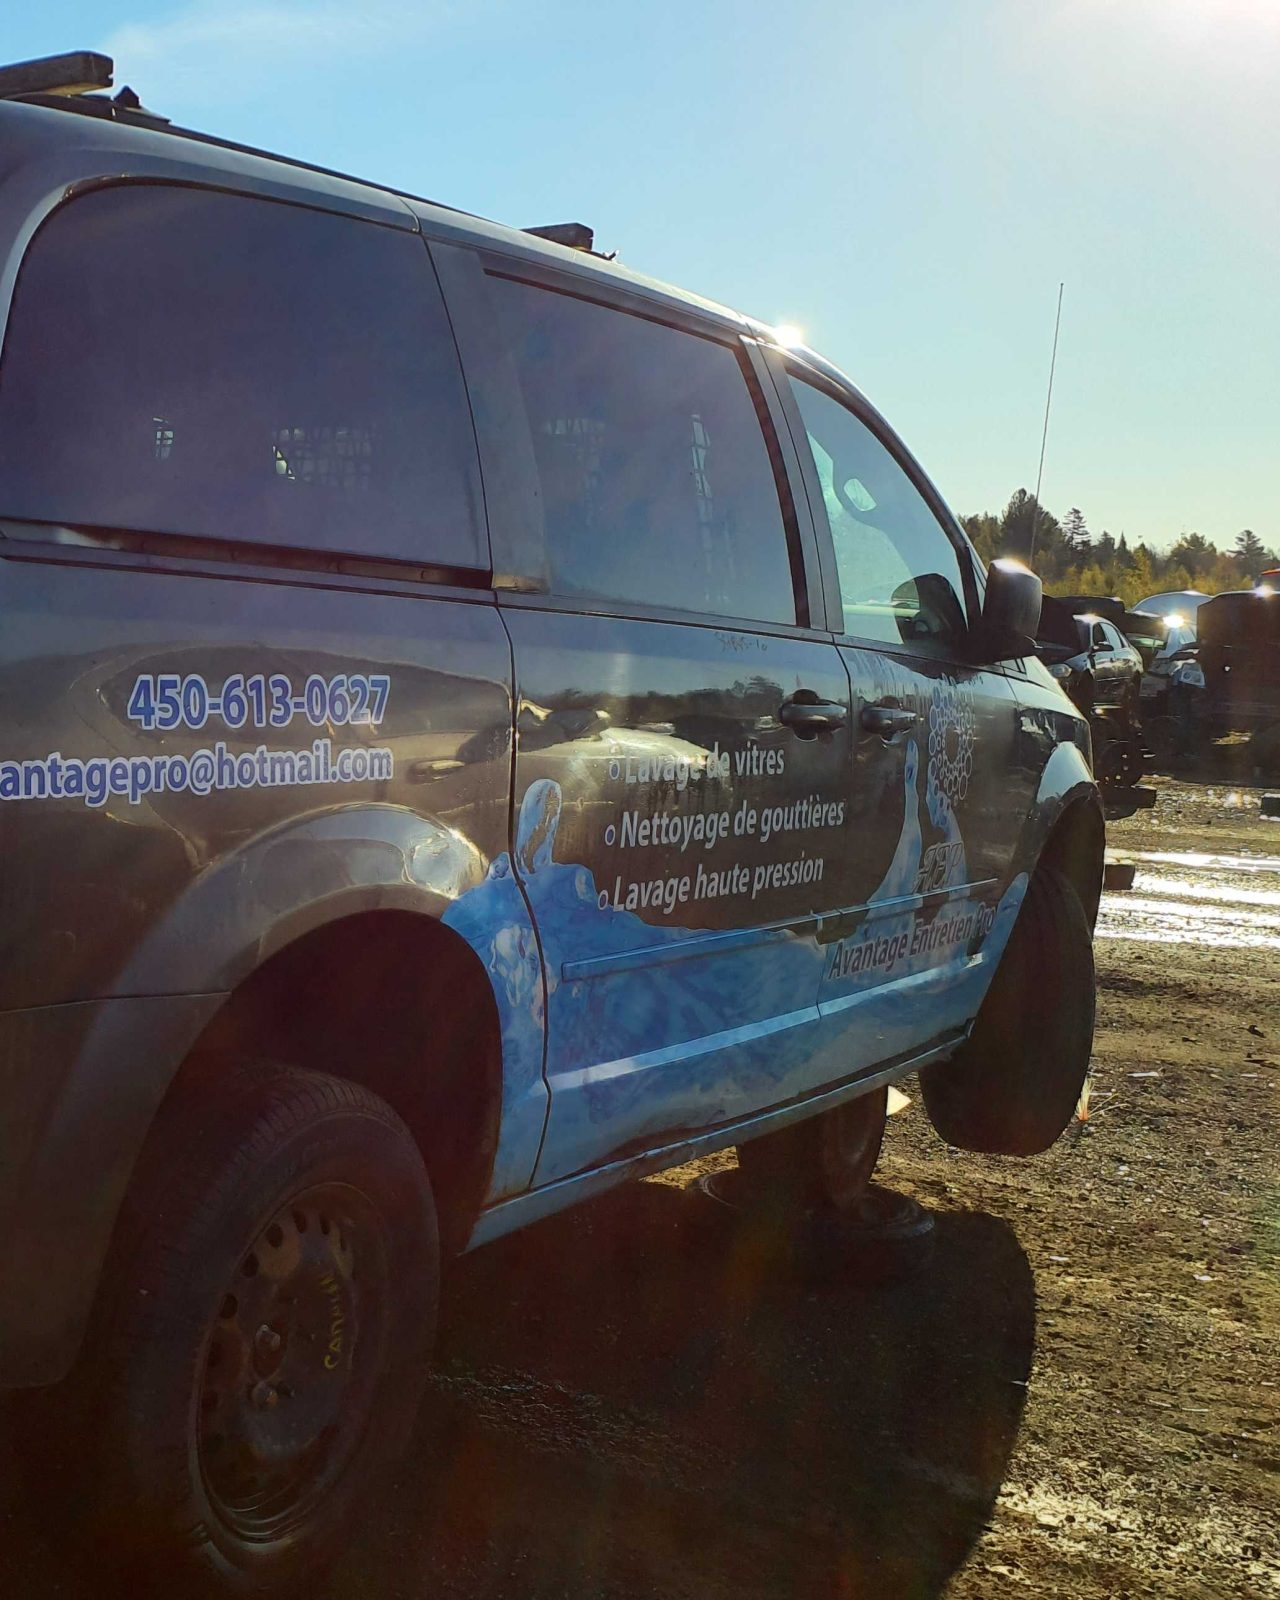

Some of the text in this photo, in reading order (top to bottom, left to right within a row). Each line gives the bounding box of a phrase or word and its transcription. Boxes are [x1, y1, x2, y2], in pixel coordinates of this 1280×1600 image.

[128, 674, 390, 729] 450-613-0627
[624, 741, 785, 791] Lavage de vitres
[620, 794, 845, 852] Nettoyage de gouttières
[613, 852, 824, 915] Lavage haute pression
[827, 932, 909, 979] Avantage
[909, 913, 974, 957] Entretien
